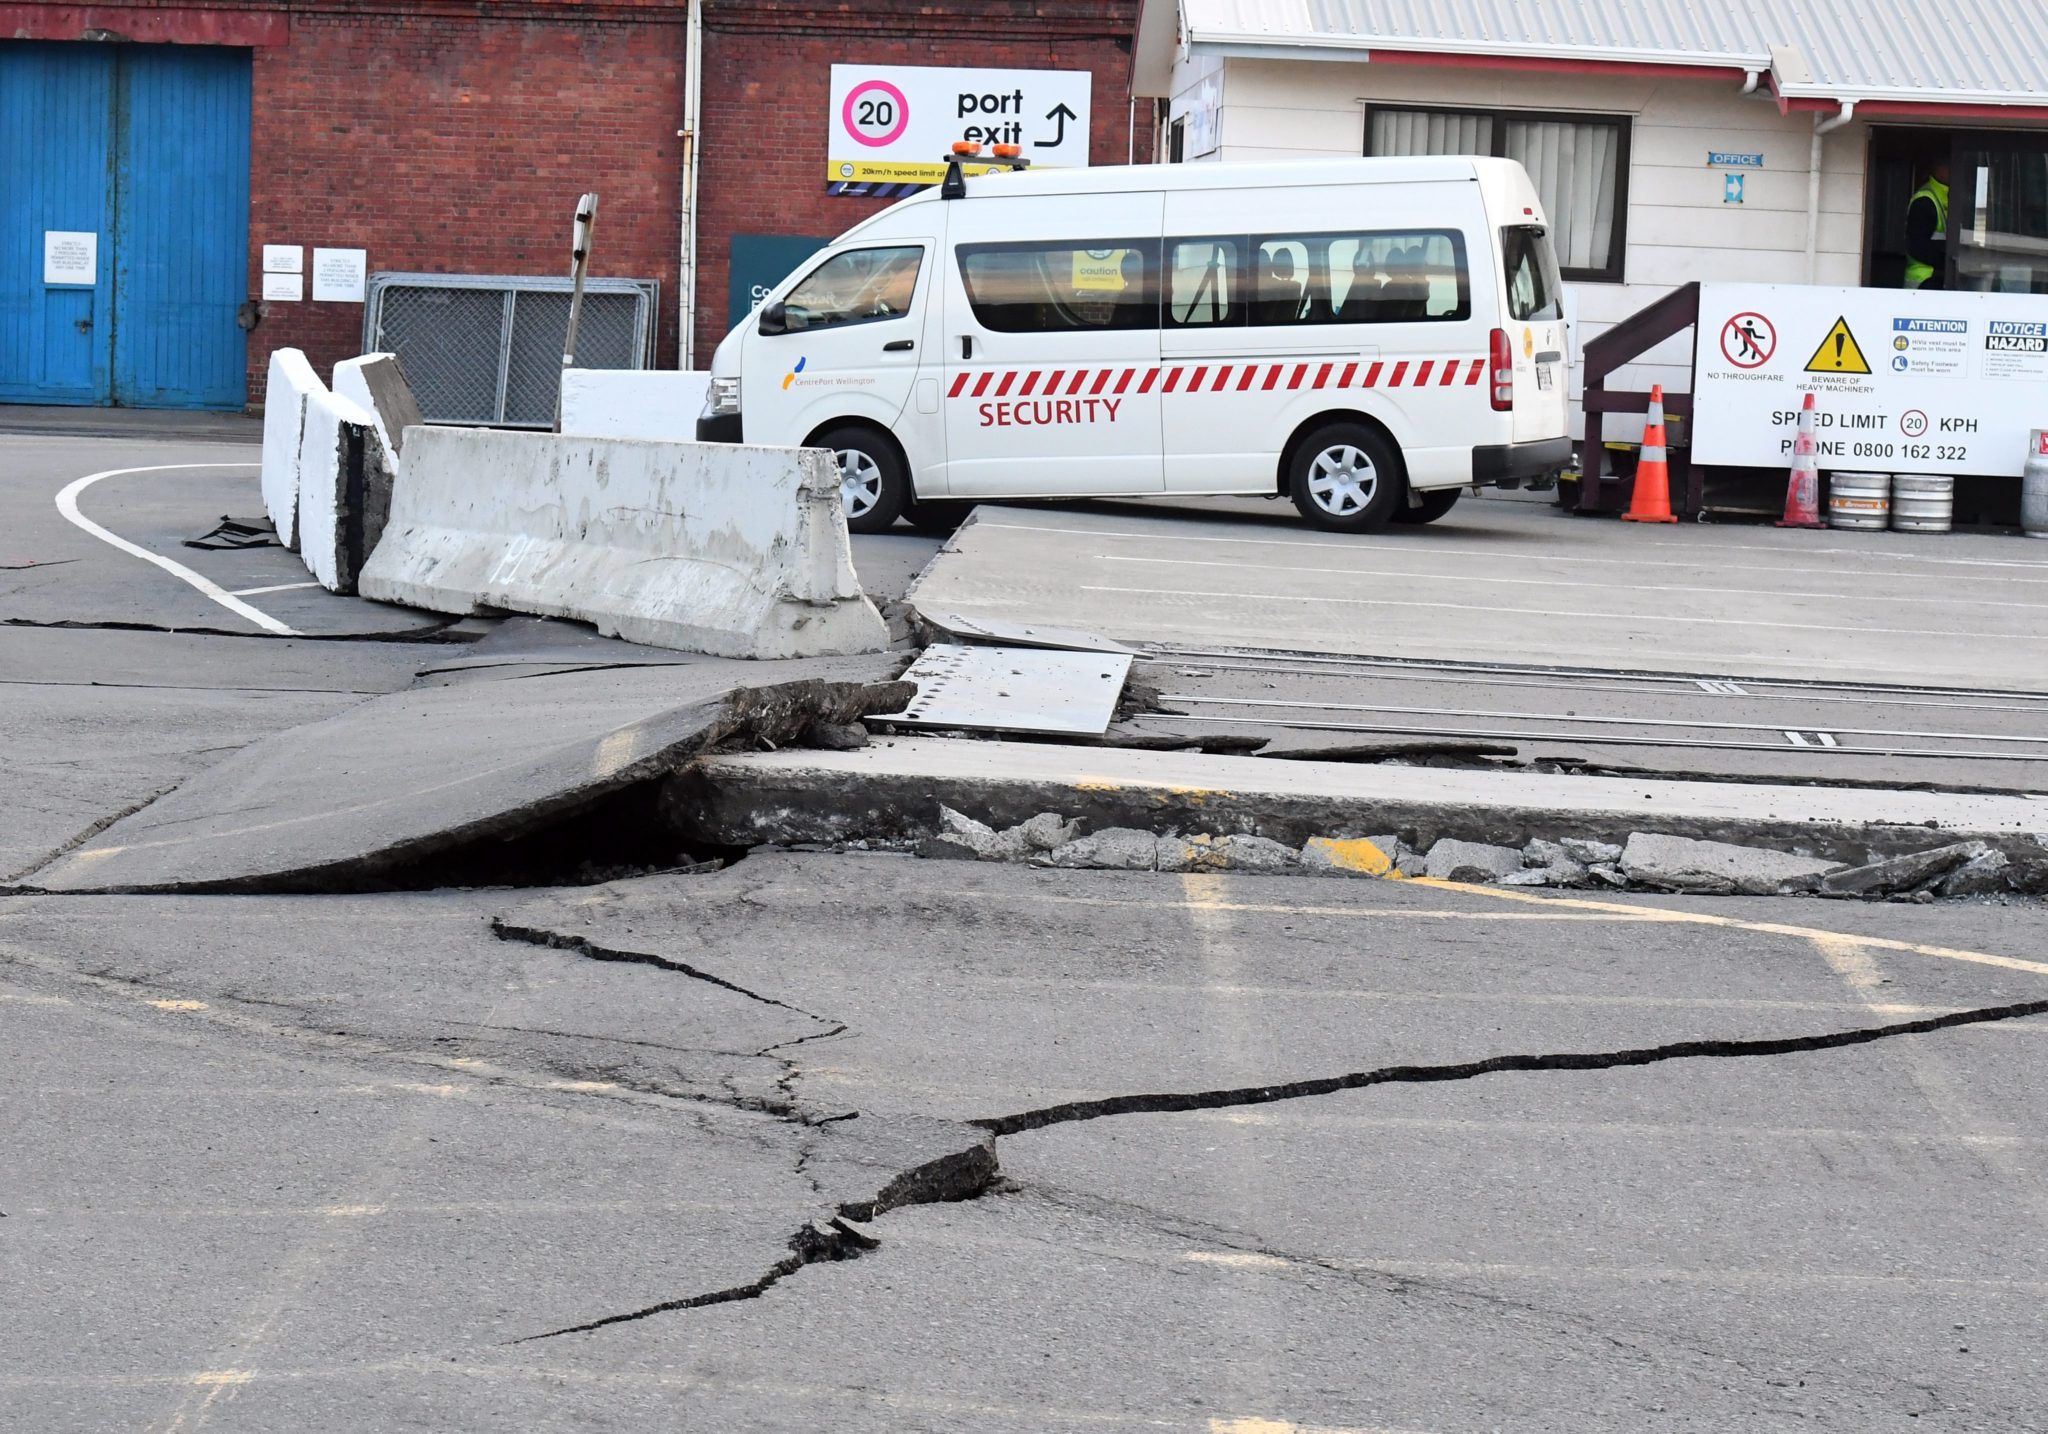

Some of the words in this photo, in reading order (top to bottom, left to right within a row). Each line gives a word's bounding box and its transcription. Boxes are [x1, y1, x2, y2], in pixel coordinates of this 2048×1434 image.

[957, 88, 1023, 118] port
[858, 100, 892, 126] 20
[964, 122, 1022, 146] exit
[1714, 154, 1758, 164] OFFICE
[862, 168, 892, 176] 20km/h
[894, 169, 918, 178] speed
[1080, 266, 1118, 275] caution
[751, 284, 772, 298] Co
[1908, 320, 1966, 332] ATTENTION
[1992, 322, 2044, 336] NOTICE
[1988, 336, 2045, 352] HAZARD
[795, 378, 833, 386] CentrePort
[836, 378, 875, 386] Wellington
[1722, 373, 1784, 382] THROUGHFARE
[1811, 376, 1847, 384] BEWARE
[1825, 385, 1875, 394] MACHINERY
[978, 398, 1122, 427] SECURITY
[1840, 414, 1888, 429] LIMIT
[1906, 418, 1922, 430] 20
[1940, 417, 1978, 433] KPH
[1780, 439, 1846, 456] PNE
[1853, 442, 1894, 458] 0800
[1900, 444, 1930, 459] 162
[1936, 445, 1967, 461] 322
